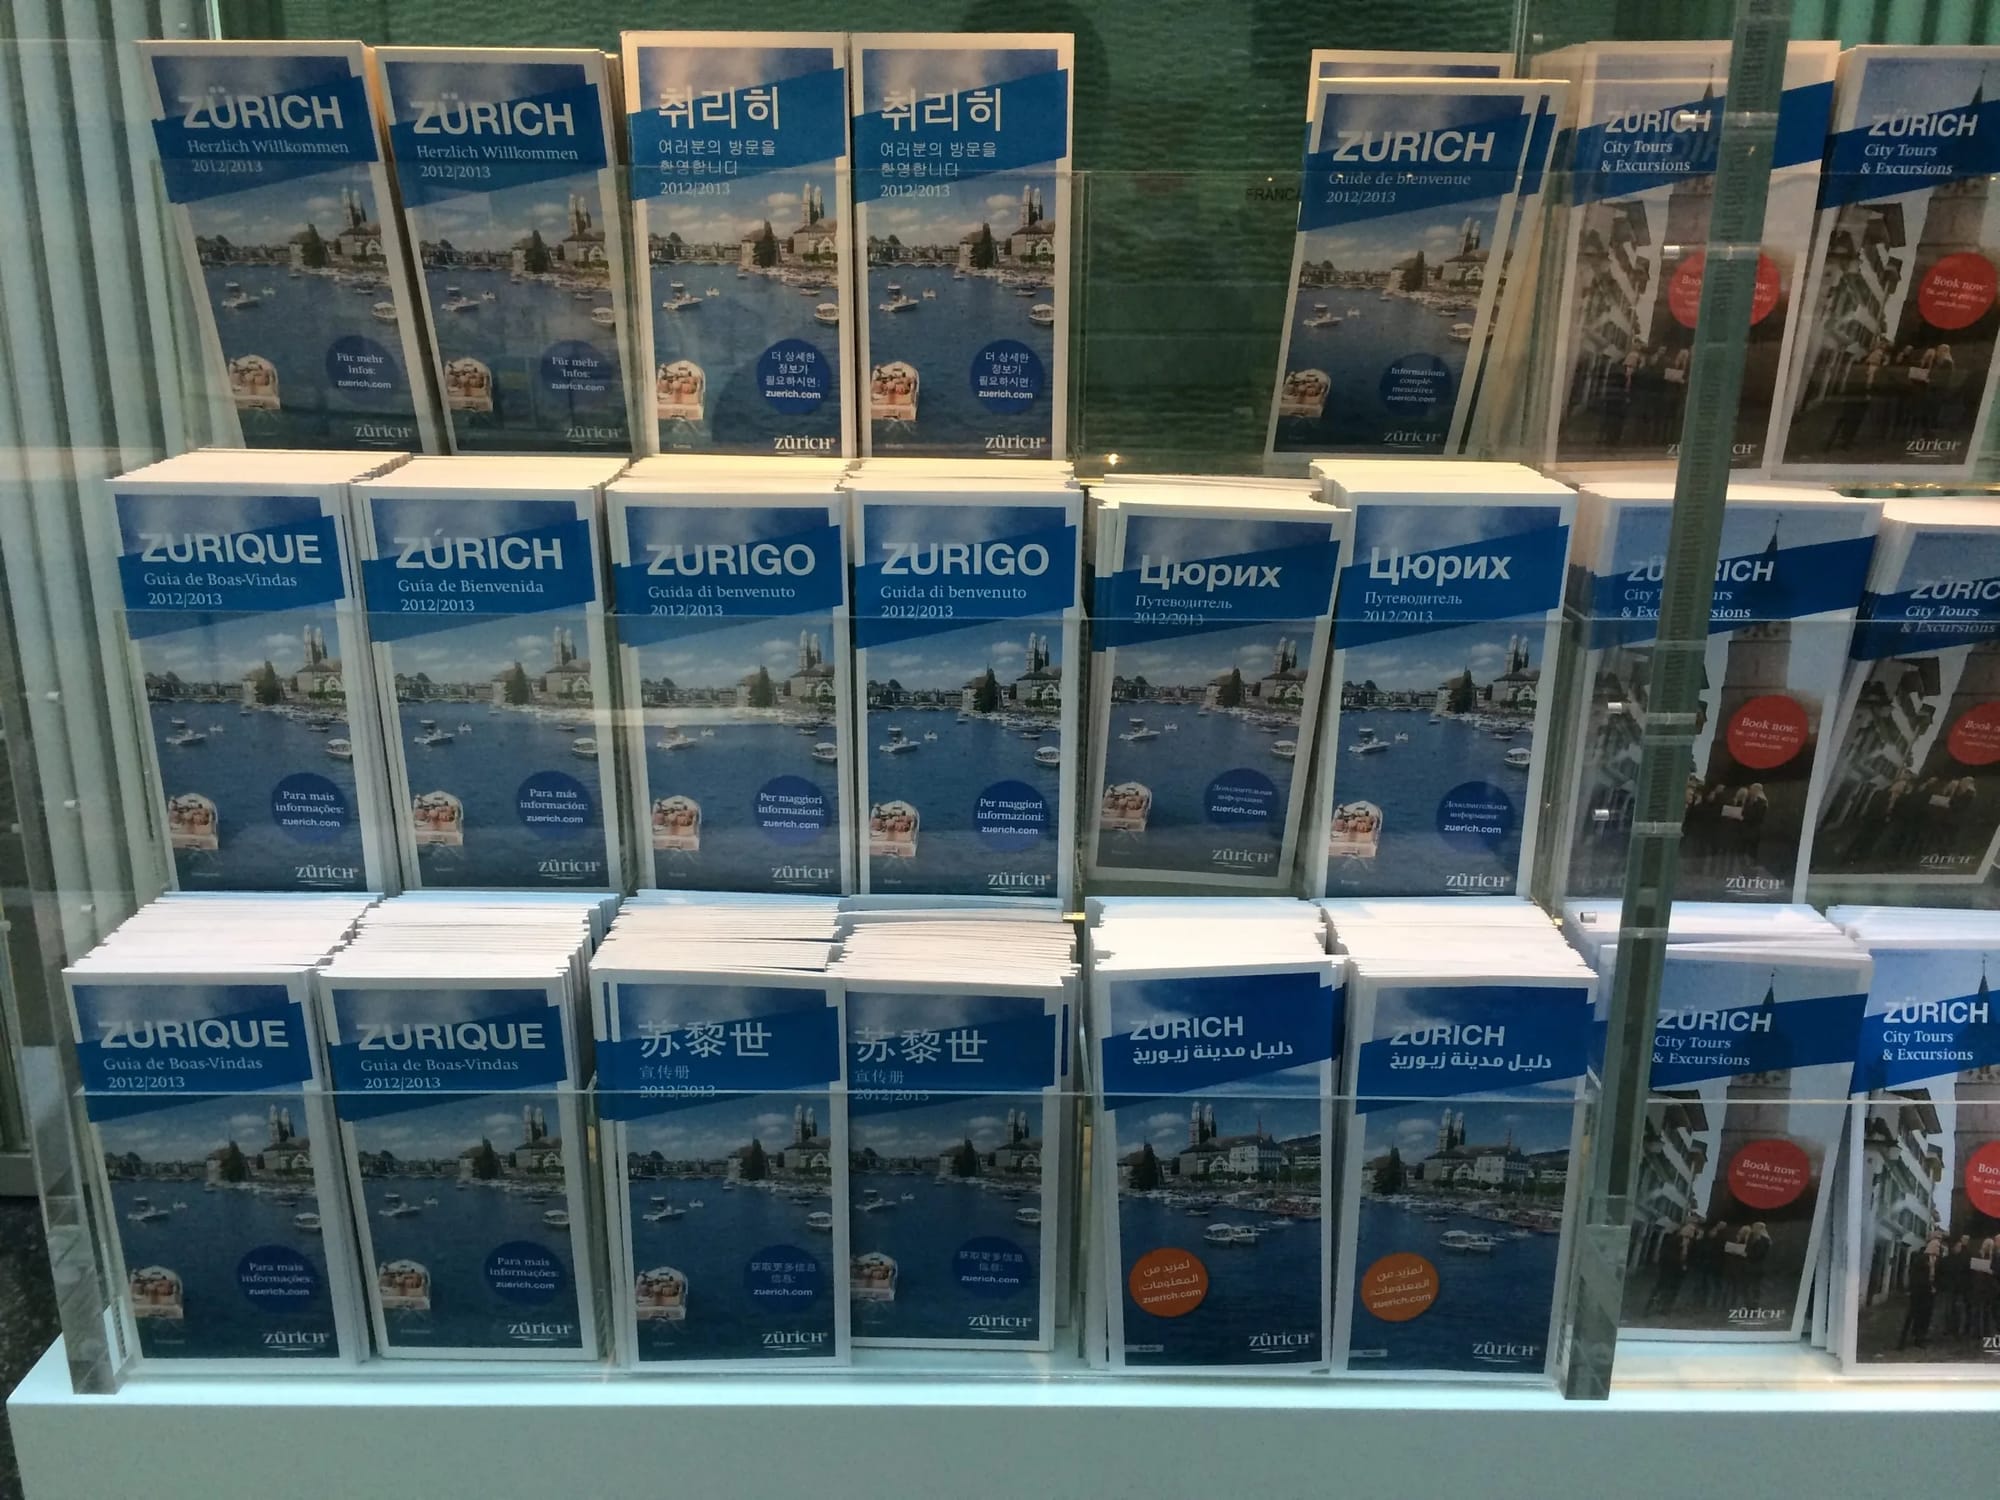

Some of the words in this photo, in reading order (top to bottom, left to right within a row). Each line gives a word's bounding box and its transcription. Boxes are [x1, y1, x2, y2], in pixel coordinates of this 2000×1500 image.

[178, 86, 344, 129] ZÜRICH
[410, 93, 575, 136] ZÜRICH
[658, 85, 779, 129] 취리히
[881, 88, 1001, 132] 취리히
[1604, 105, 1712, 133] ZÜRICH
[1868, 108, 1979, 137] ZÜRICH
[187, 140, 250, 153] Herzlich
[252, 140, 350, 154] Willkommen
[416, 145, 479, 159] Herzlich
[482, 146, 579, 160] Willkommen
[659, 139, 721, 155] 여러분의
[729, 139, 776, 156] 방문을
[880, 142, 942, 158] 여러분의
[950, 142, 997, 158] 방문을
[1333, 130, 1496, 162] ZURICH
[1604, 140, 1631, 156] City
[1634, 141, 1673, 154] Tours
[1864, 144, 1893, 160] City
[1898, 144, 1937, 157] Tours
[192, 159, 264, 175] 2012/2013
[421, 165, 491, 180] 2012/2013
[1601, 160, 1611, 172] &
[1616, 159, 1690, 172] Excursions
[1860, 162, 1872, 174] &
[1876, 162, 1953, 175] Excursions
[1329, 172, 1373, 185] Guide
[1377, 173, 1393, 185] de
[1396, 172, 1471, 185] bienvenue
[660, 181, 731, 196] 2012/2013
[880, 184, 950, 199] 2012/2013
[1326, 191, 1396, 205] 2012/2013
[552, 356, 569, 366] Für
[572, 358, 599, 368] mehr
[771, 352, 781, 361] 더
[985, 352, 995, 361] 더
[562, 369, 591, 378] Infos:
[551, 382, 605, 392] zuerich.com
[766, 389, 821, 399] zuerich.com
[978, 390, 1033, 399] zuerich.com
[138, 533, 322, 565] ZURIQUE
[394, 528, 563, 570] ZÚRICH
[646, 543, 816, 576] ZURIGO
[881, 543, 1050, 576] ZURIGO
[1369, 547, 1512, 587] Цюрих
[144, 573, 181, 586] Guia
[185, 573, 203, 586] de
[208, 573, 297, 587] Boas-Vindas
[1140, 555, 1283, 592] Цюрих
[438, 579, 456, 592] de
[461, 579, 544, 593] Bienvenida
[648, 586, 693, 599] Guida
[698, 586, 711, 598] di
[717, 586, 796, 599] benvenuto
[880, 586, 925, 599] Guida
[929, 586, 943, 598] di
[949, 586, 1027, 599] benvenuto
[148, 592, 223, 608] 2012/2013
[1135, 595, 1233, 609] Путеводитель
[1365, 592, 1462, 607] Путеводитель
[1624, 589, 1653, 603] City
[401, 598, 475, 613] 2012/2013
[650, 604, 724, 619] 2012/2013
[881, 604, 954, 619] 2012/2013
[1621, 606, 1632, 618] &
[1905, 606, 1935, 620] City
[1939, 606, 1979, 618] Tours
[1901, 622, 1911, 633] &
[1914, 621, 1995, 634] Excursions
[282, 791, 307, 801] Para
[310, 792, 335, 801] mais
[529, 788, 553, 798] Para
[556, 788, 577, 799] más
[760, 792, 776, 803] Per
[778, 793, 823, 806] maggiori
[758, 805, 824, 817] informazioni:
[980, 798, 996, 808] Per
[998, 799, 1043, 811] maggiori
[282, 817, 340, 828] zuerich.com
[526, 814, 583, 824] zuerich.com
[977, 810, 1044, 822] informazioni:
[763, 820, 820, 830] zuerich.com
[981, 825, 1039, 836] zuerich.com
[1444, 824, 1502, 834] zuerich.com
[1883, 997, 1989, 1024] ZÜRICH
[1656, 1005, 1772, 1033] ZÜRICH
[98, 1020, 289, 1049] ZURIQUE
[1130, 1014, 1244, 1041] ZÜRICH
[356, 1023, 545, 1051] ZURIQUE
[638, 1020, 772, 1058] 苏黎世
[1654, 1035, 1685, 1049] City
[1689, 1036, 1731, 1049] Tours
[1883, 1030, 1912, 1045] City
[1915, 1030, 1953, 1043] Tours
[855, 1027, 988, 1063] 苏黎世
[1250, 1041, 1293, 1060] دليل
[1132, 1046, 1189, 1064] زيوريخ
[1193, 1044, 1245, 1062] مدينة
[1390, 1051, 1446, 1070] زيوريخ
[1652, 1053, 1663, 1064] &
[1669, 1053, 1750, 1066] Excursions
[1883, 1049, 1893, 1060] &
[1897, 1049, 1973, 1061] Excursions
[103, 1058, 141, 1070] Guia
[146, 1058, 165, 1070] de
[169, 1057, 263, 1070] Boas-Vindas
[361, 1059, 398, 1072] Guia
[402, 1059, 421, 1071] de
[427, 1058, 519, 1071] Boas-Vindas
[1451, 1052, 1503, 1070] مدينة
[1508, 1054, 1552, 1072] دليل
[640, 1065, 690, 1080] 宣传册
[855, 1069, 904, 1084] 宣传册
[108, 1076, 185, 1090] 2012/2013
[364, 1077, 441, 1091] 2012/2013
[1742, 1159, 1770, 1172] Book
[497, 1257, 522, 1267] Para
[524, 1258, 550, 1267] mais
[496, 1281, 555, 1290] zuerich.com
[753, 1288, 813, 1296] zuerich.com
[1142, 1288, 1202, 1304] zuerich.com
